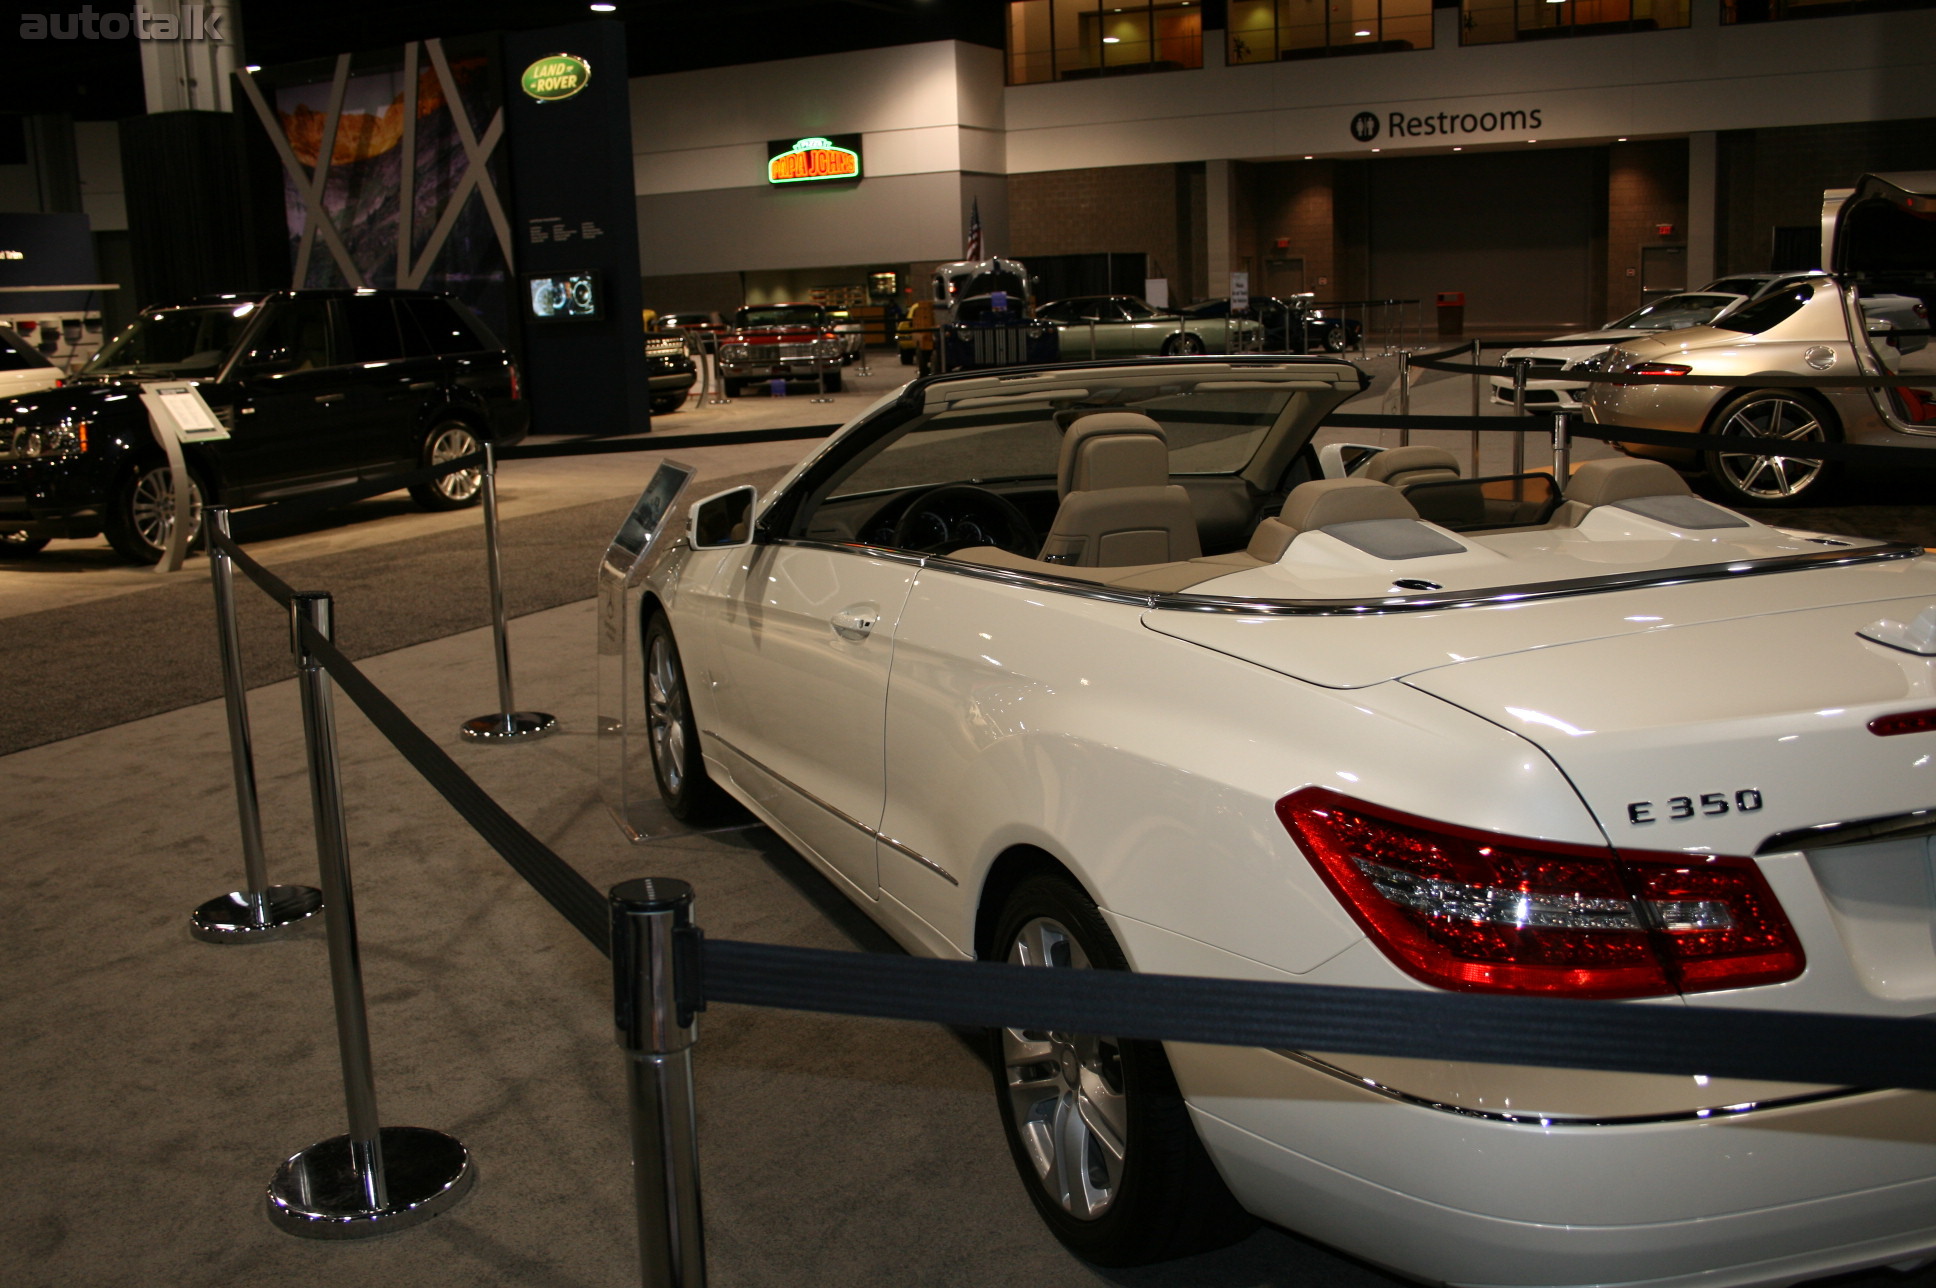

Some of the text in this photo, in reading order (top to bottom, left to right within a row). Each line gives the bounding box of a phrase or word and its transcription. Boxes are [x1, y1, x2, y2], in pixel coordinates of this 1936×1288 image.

[533, 63, 566, 78] LAND
[537, 75, 577, 92] ROVER
[1389, 109, 1542, 138] Restrooms
[771, 151, 808, 179] PAPA
[1627, 788, 1763, 825] E 350
